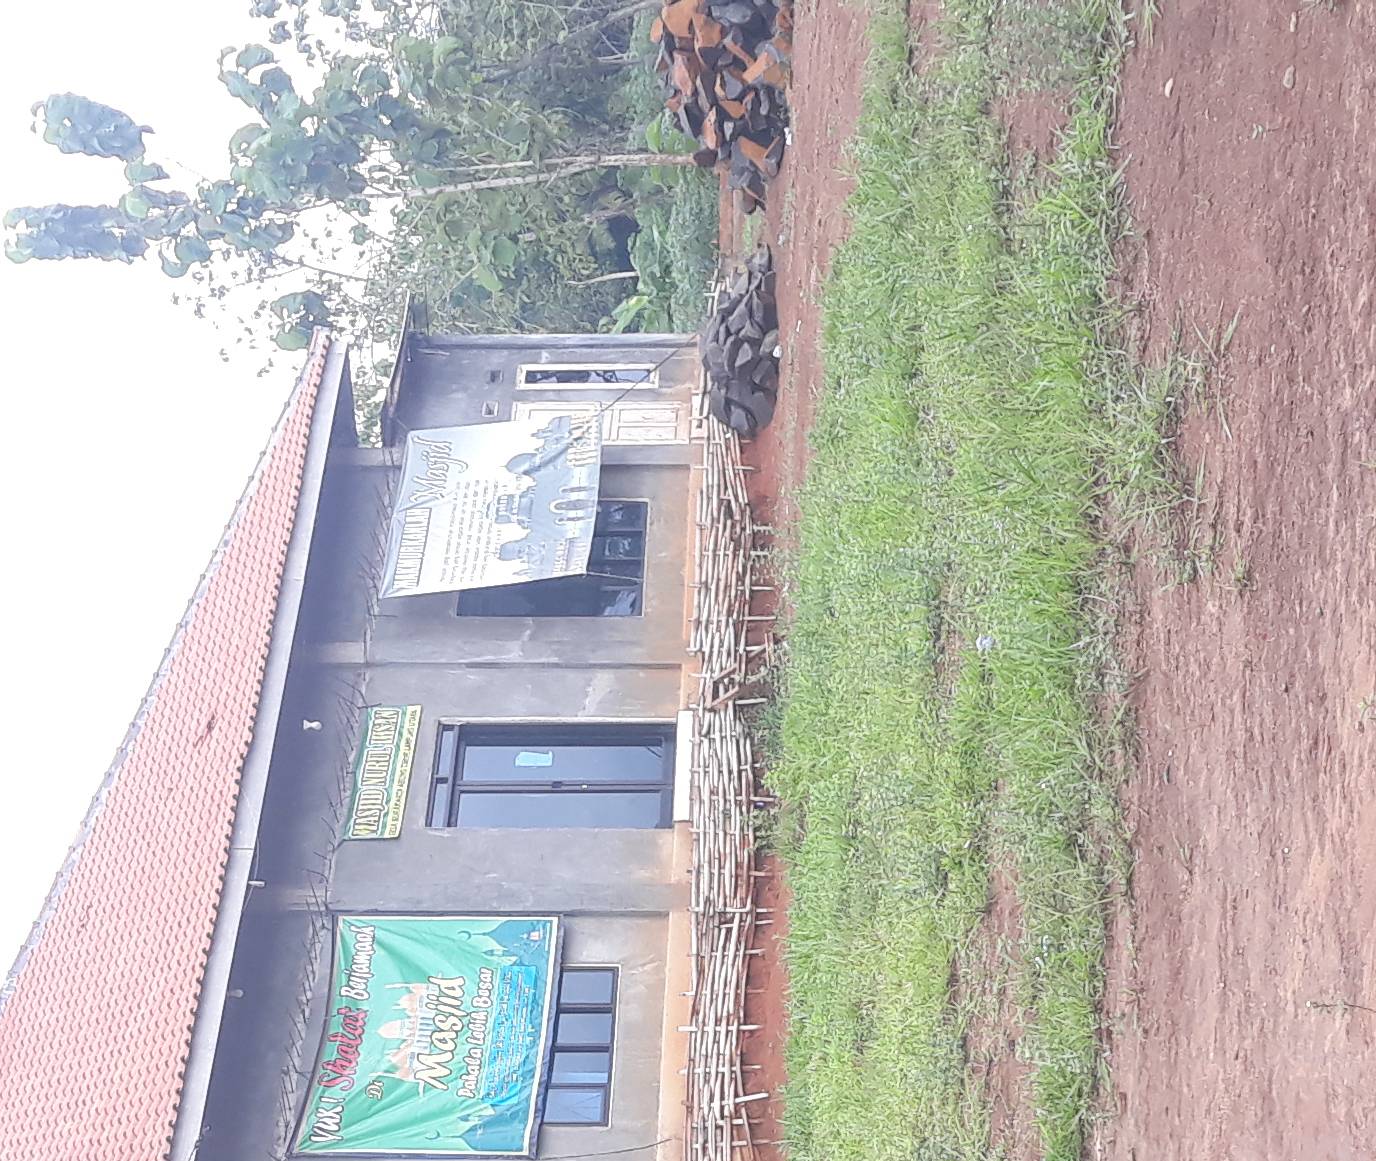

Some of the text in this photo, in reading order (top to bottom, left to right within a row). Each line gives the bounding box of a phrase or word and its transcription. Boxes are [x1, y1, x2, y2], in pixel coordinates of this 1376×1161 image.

[392, 436, 468, 589] MAKMURKANLAH Masjid
[352, 709, 400, 836] MASJID NURUL IHSAN
[365, 1080, 384, 1100] Di
[414, 975, 467, 1091] Masjid
[456, 1047, 483, 1098] Pahala
